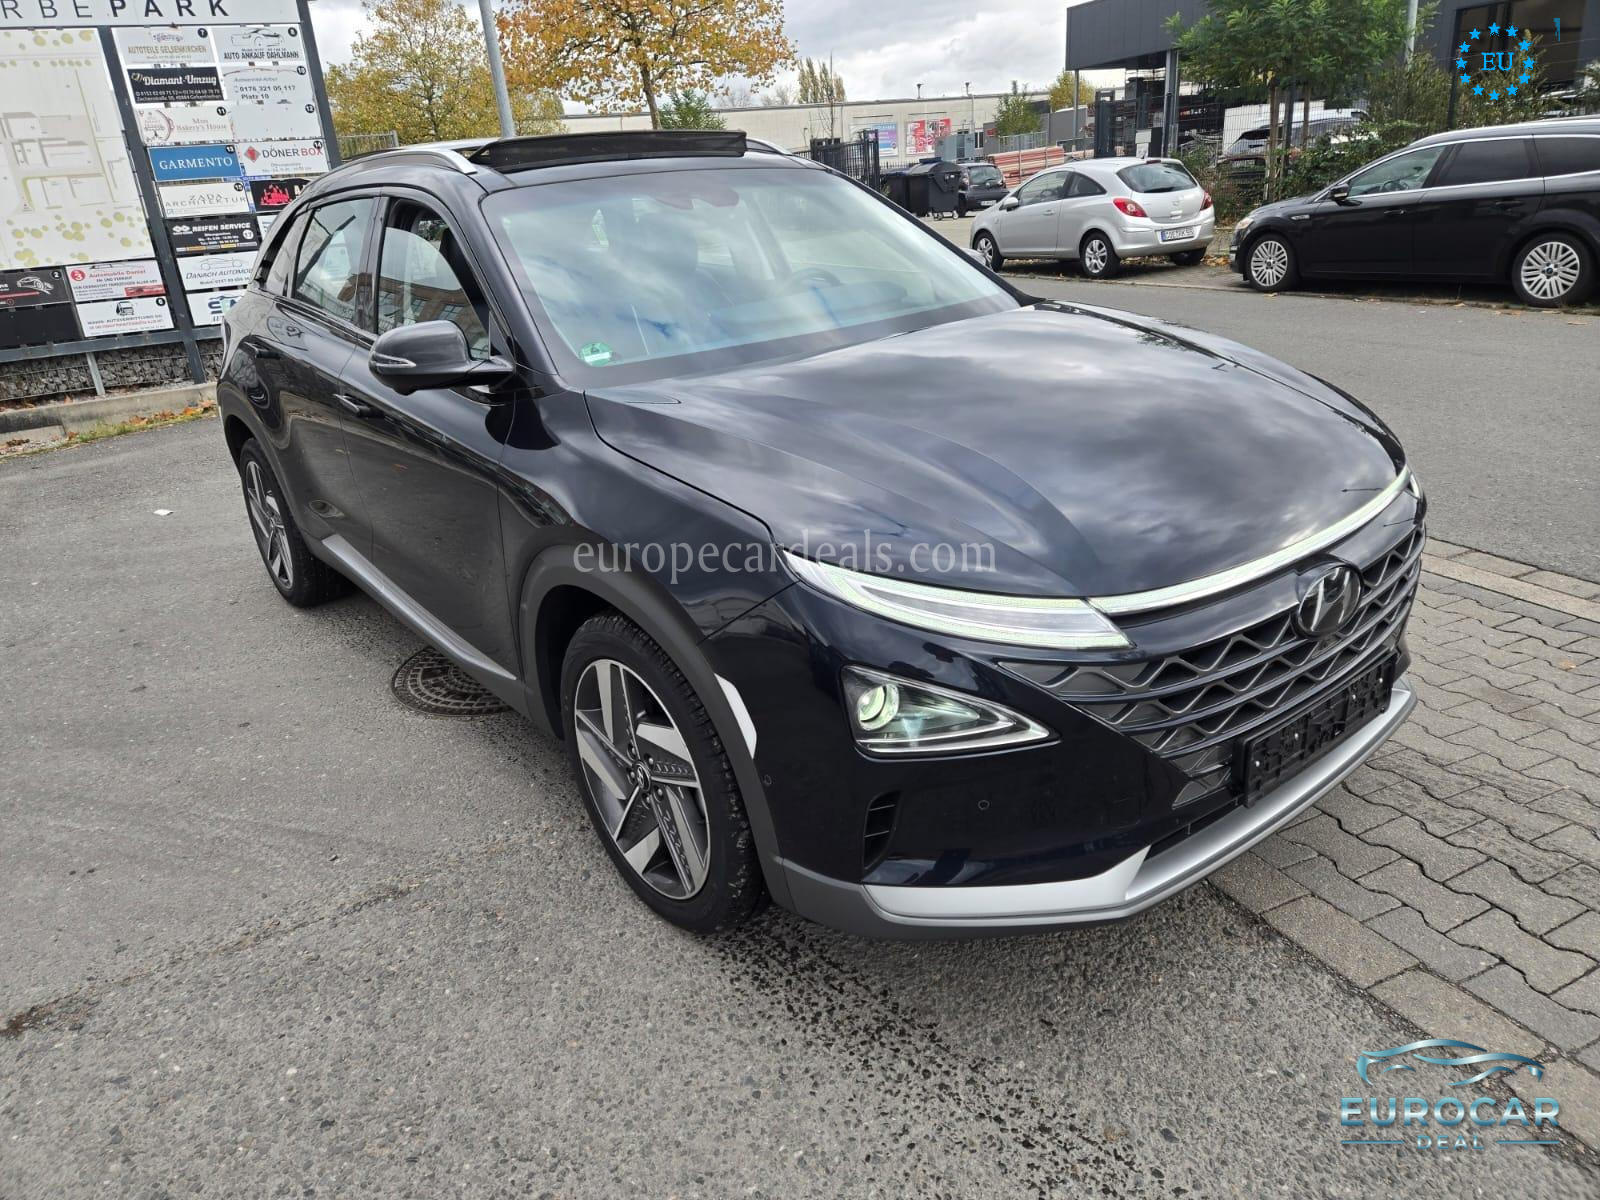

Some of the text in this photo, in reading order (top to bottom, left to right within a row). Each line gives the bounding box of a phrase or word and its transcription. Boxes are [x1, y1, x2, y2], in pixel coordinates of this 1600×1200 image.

[128, 44, 207, 54] AUTOTEILE GELSENKIRCHEN
[224, 50, 300, 60] AUTO ANKAUF DAHLMANN
[262, 147, 324, 158] DÖNER BOX
[159, 156, 233, 170] GARMENTO
[220, 222, 251, 231] SERVICE
